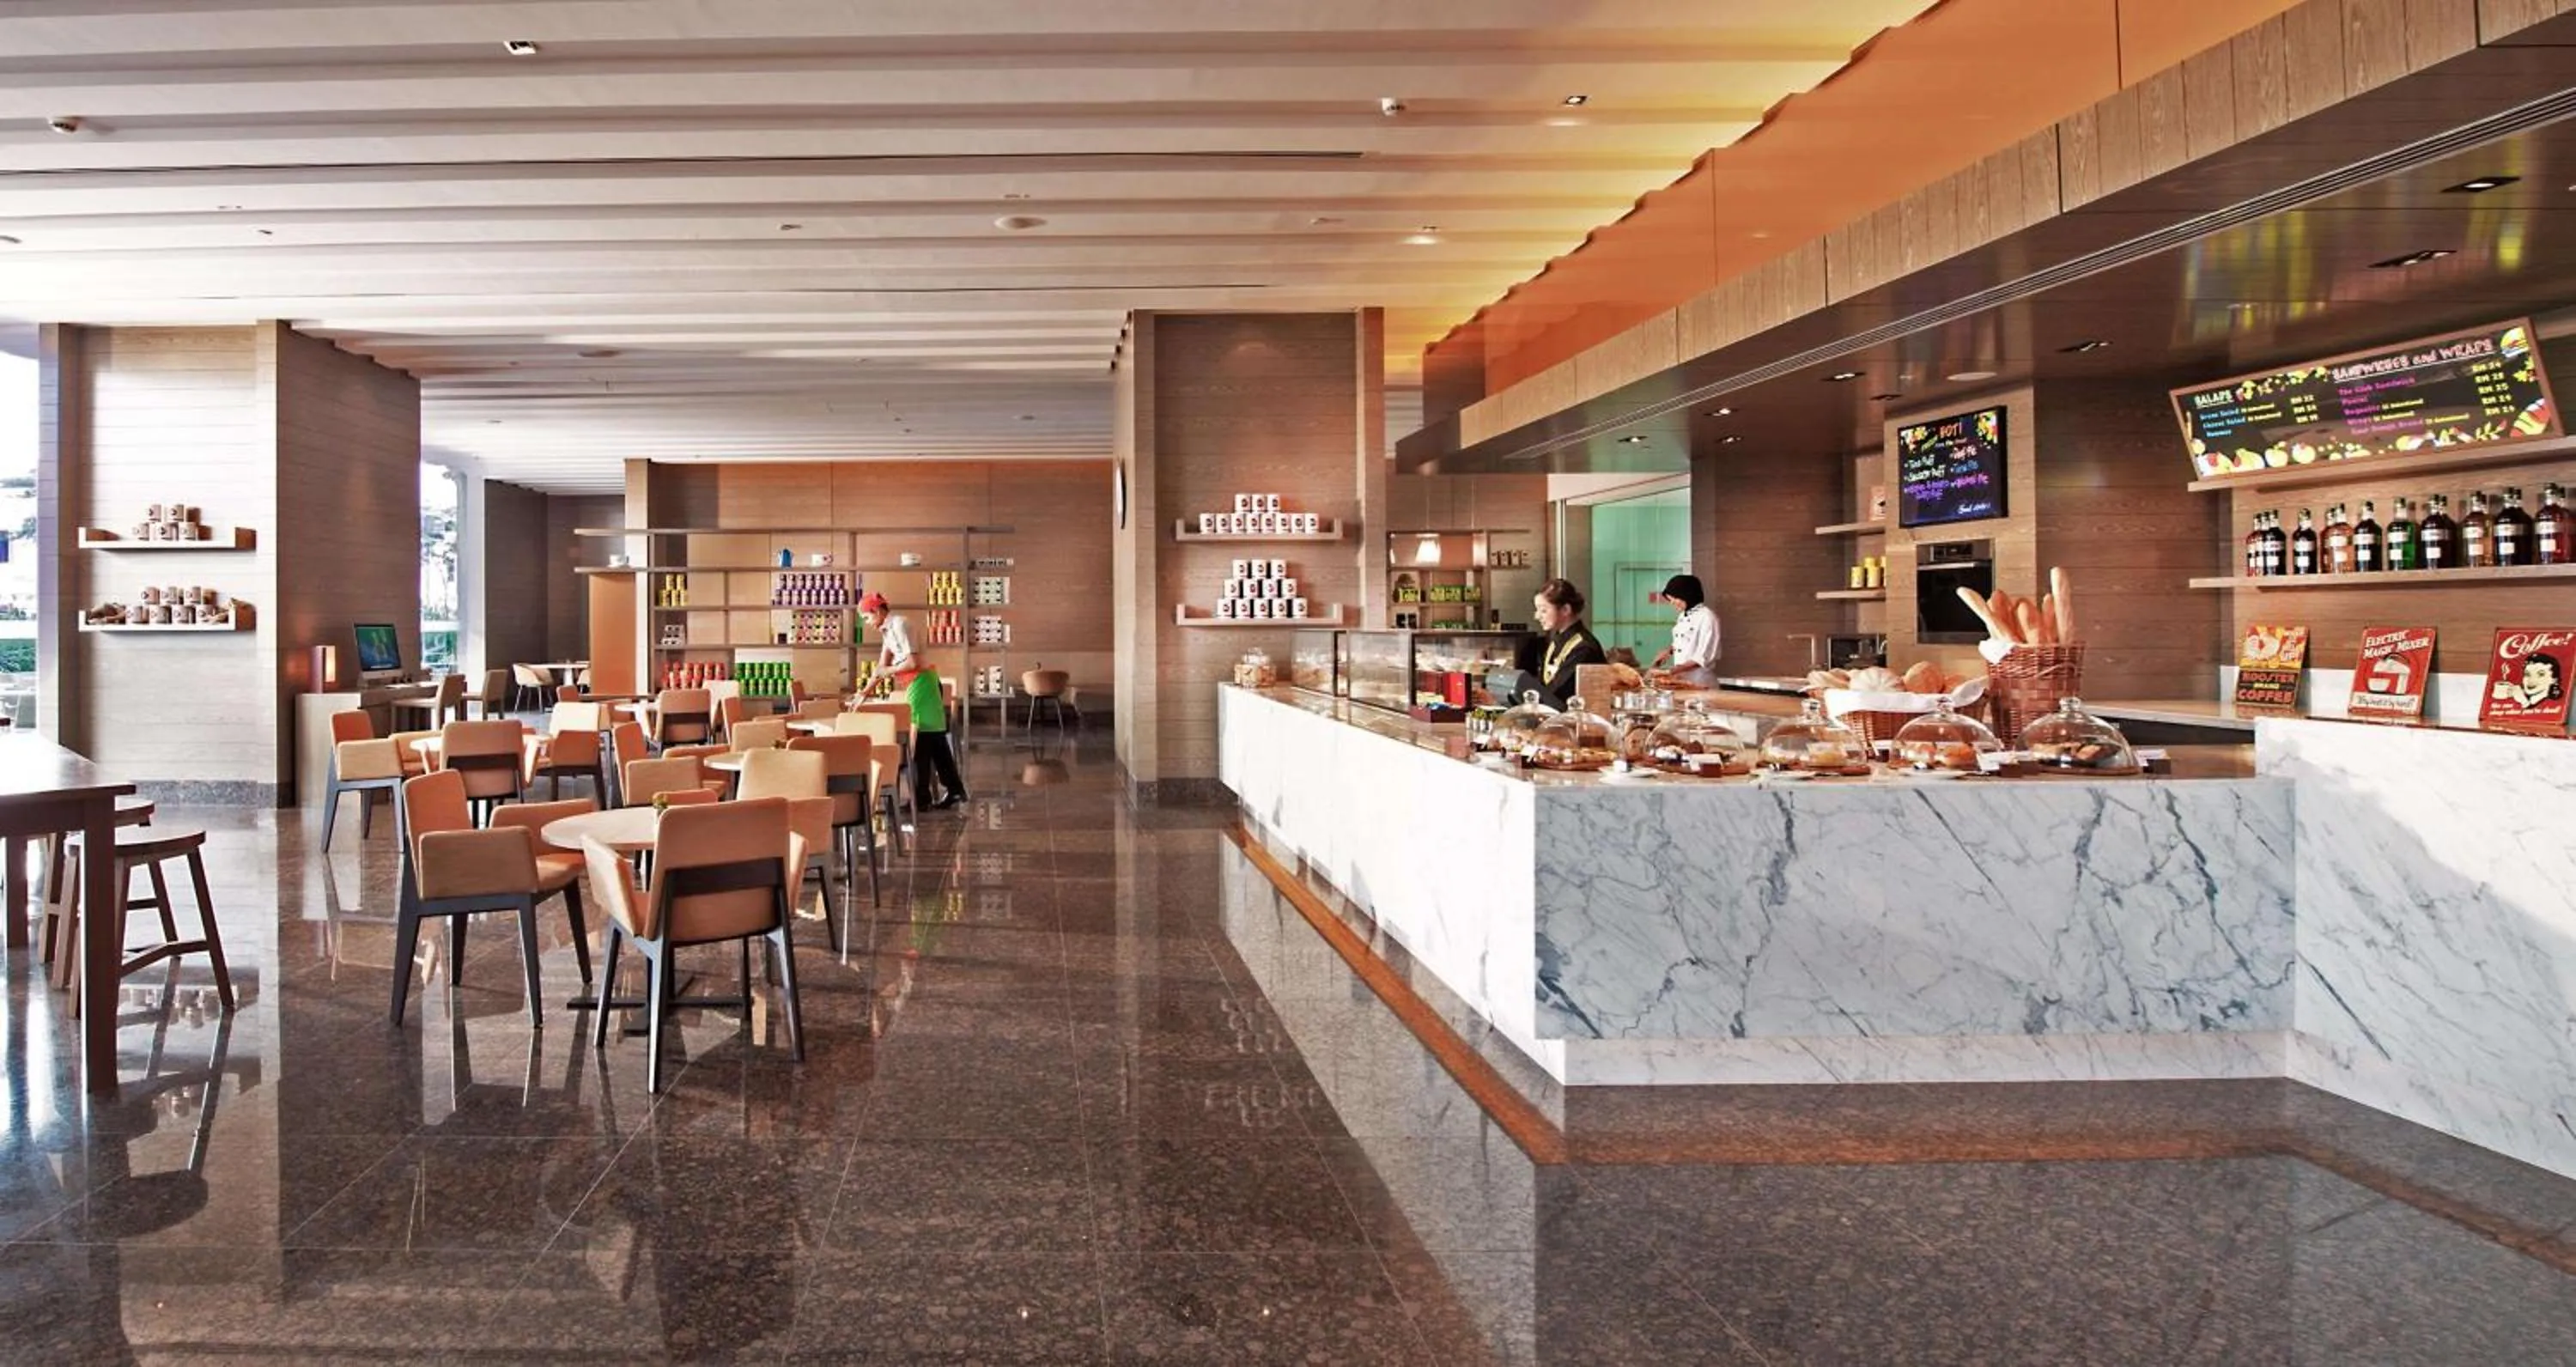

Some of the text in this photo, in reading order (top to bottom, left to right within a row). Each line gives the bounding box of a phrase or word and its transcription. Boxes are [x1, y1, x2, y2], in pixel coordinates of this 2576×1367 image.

[2332, 338, 2493, 380] SANDWICHES and WRAPS
[2195, 389, 2233, 408] SALADS
[2362, 637, 2430, 659] MAGIC MIXER
[2366, 629, 2411, 648] ELECTRIC
[2499, 633, 2574, 659] Coffee!
[2242, 671, 2296, 684] ROOSTER
[2239, 690, 2293, 702] COFFEE
